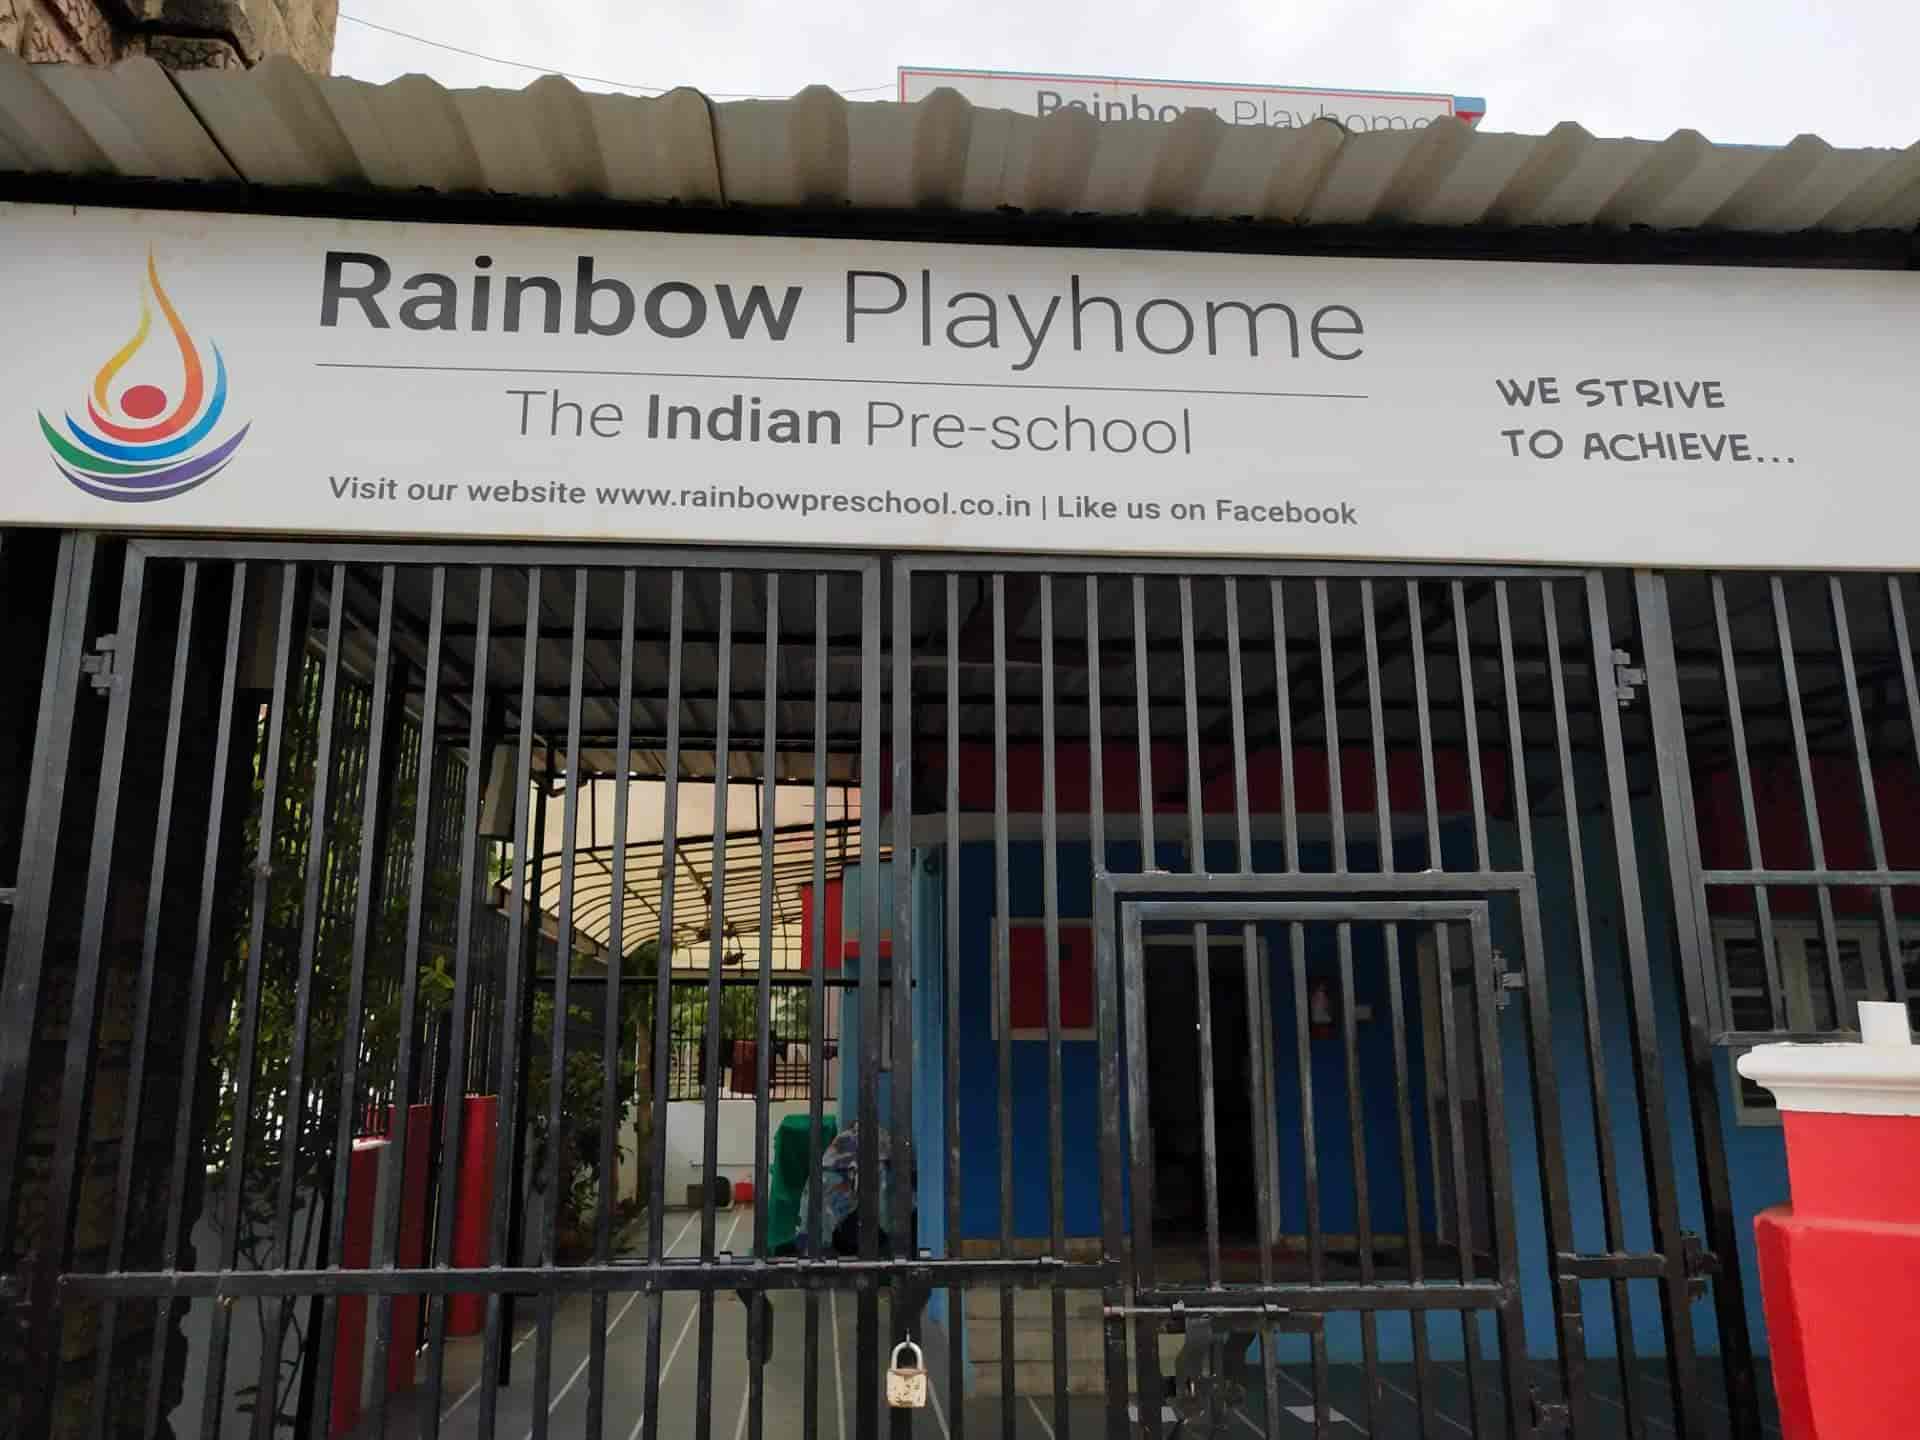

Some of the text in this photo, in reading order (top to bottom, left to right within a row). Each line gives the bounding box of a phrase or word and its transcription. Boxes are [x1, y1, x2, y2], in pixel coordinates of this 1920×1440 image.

[319, 250, 1364, 371] Rainbow Playhome
[1496, 376, 1725, 409] WE STRIVE
[506, 390, 1191, 454] The Indian Pre-school
[1501, 429, 1563, 459] TO
[329, 477, 398, 500] Visit
[407, 484, 458, 501] our
[467, 479, 586, 504] website
[597, 486, 1030, 517] www.rainbowpreschool.co.in
[1059, 496, 1117, 519] Like
[1127, 503, 1161, 520] us
[1170, 504, 1205, 521] on
[1216, 500, 1357, 525] Facebook
